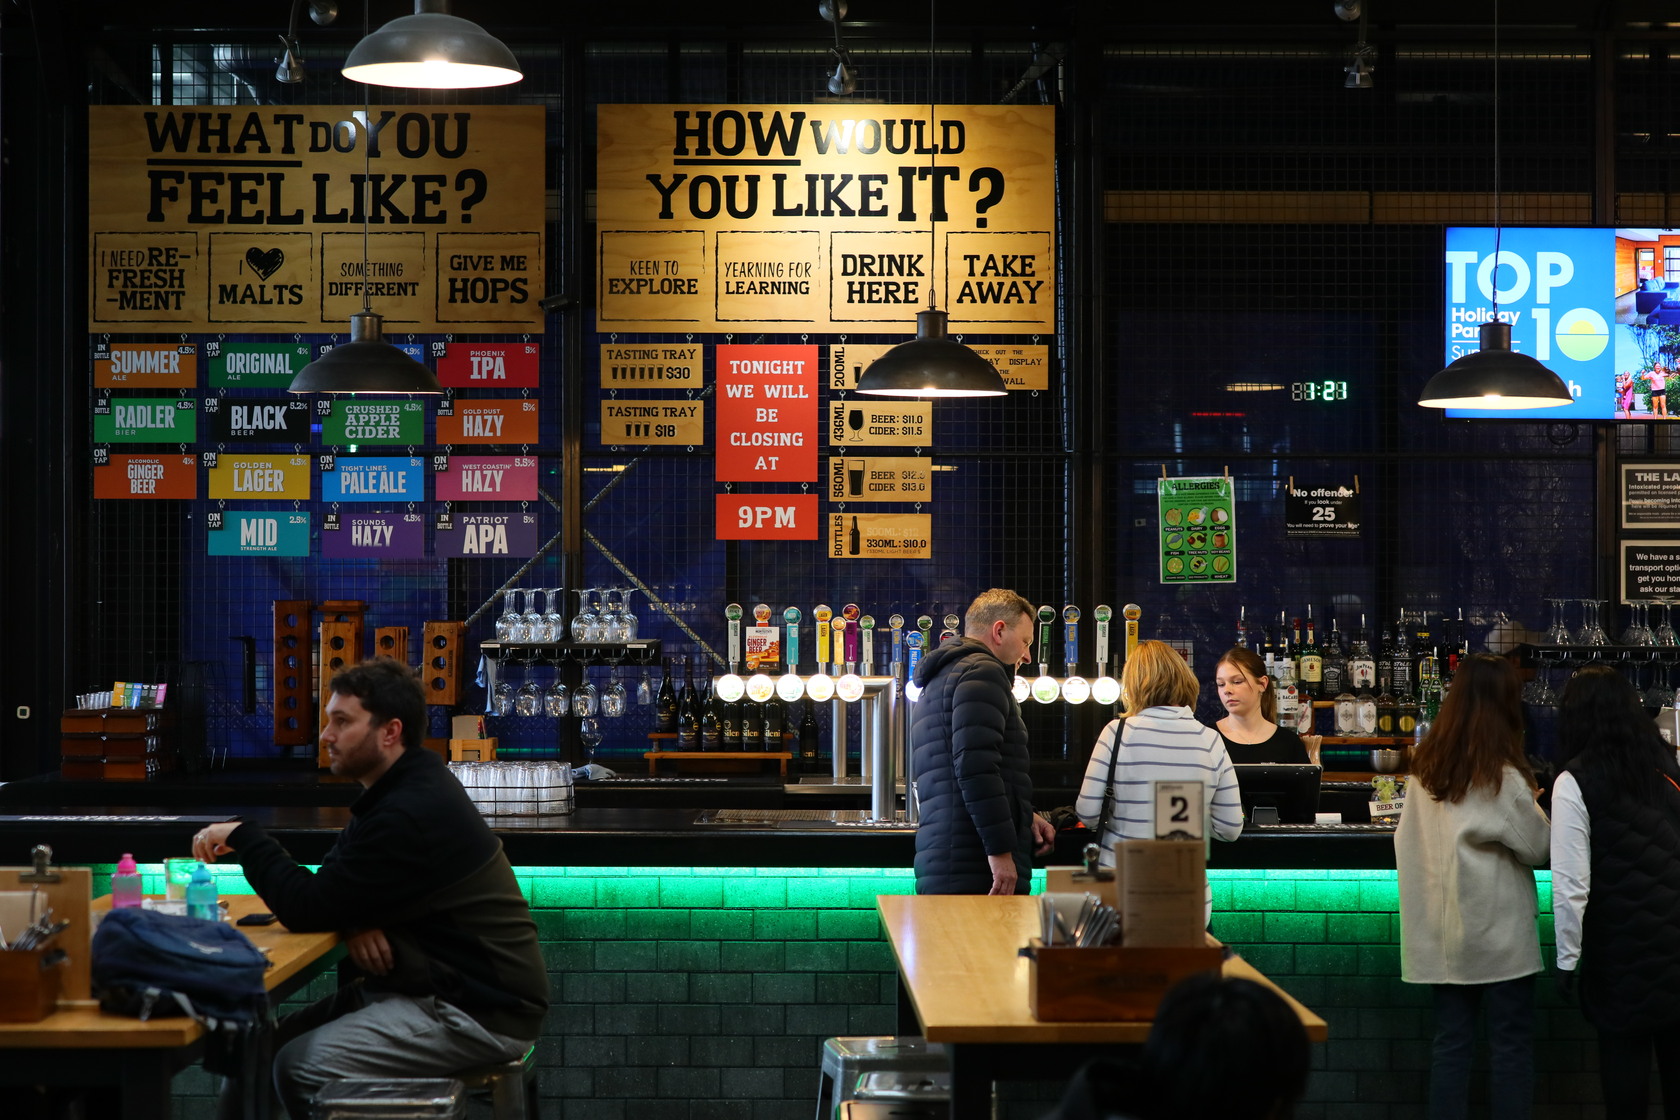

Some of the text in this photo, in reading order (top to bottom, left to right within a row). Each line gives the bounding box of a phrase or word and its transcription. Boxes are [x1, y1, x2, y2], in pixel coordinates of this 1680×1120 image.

[144, 111, 471, 158] WHAT DO YOU
[673, 110, 965, 157] HOW WOULD
[147, 169, 487, 224] FEEL LIKE?
[646, 174, 760, 219] YOU
[772, 174, 889, 216] LIKE
[110, 250, 145, 268] NEED
[147, 247, 191, 267] RE-
[449, 255, 527, 271] GIVE ME
[841, 254, 925, 277] DRINK
[963, 254, 1036, 277] TAKE
[340, 261, 404, 278] SOMETHING
[630, 261, 679, 276] KEEN TO
[724, 261, 811, 278] YEARNING FOR
[107, 269, 185, 289] FRESH
[1446, 251, 1574, 304] TOP
[218, 284, 303, 305] MALTS
[329, 282, 419, 297] DIFFERENT
[448, 278, 529, 304] HOPS
[608, 279, 698, 295] EXPLORE
[725, 281, 809, 295] LEARNING
[847, 282, 919, 304] HERE
[956, 280, 1044, 304] AWAY
[106, 291, 185, 310] -MENT
[432, 342, 445, 350] ON
[607, 350, 697, 359] TASTING TRAY
[111, 351, 180, 374] SUMMER
[226, 353, 293, 374] ORIGINAL
[470, 357, 506, 379] IPA
[730, 361, 804, 374] TONIGHT
[834, 347, 845, 387] 200ML
[666, 367, 690, 380] $30
[726, 385, 808, 398] WE WILL
[115, 406, 175, 428] RADLER
[231, 406, 287, 429] BLACK
[345, 406, 400, 414] CRUSHED
[607, 407, 697, 417] TASTING TRAY
[756, 408, 778, 422] BE
[345, 415, 400, 425] APPLE
[463, 415, 504, 437] HAZY
[834, 403, 844, 441] 436ML
[871, 415, 923, 424] BEER: $11.0
[345, 427, 400, 439] CIDER
[655, 424, 676, 438] $18
[730, 432, 803, 446] CLOSING
[869, 427, 922, 435] CIDER: $11.5
[94, 449, 106, 457] ON
[434, 456, 446, 464] ON
[128, 465, 164, 479] GINGER
[755, 457, 779, 470] AT
[233, 470, 284, 492] LAGER
[341, 472, 406, 493] PALE ALE
[462, 470, 503, 492] HAZY
[871, 472, 895, 480] BEER
[1635, 473, 1659, 481] THE
[130, 480, 156, 494] BEER
[869, 483, 895, 491] CIDER
[1172, 482, 1220, 490] ALLERGIES
[1293, 489, 1307, 497] No
[208, 513, 220, 521] ON
[738, 506, 796, 528] 9PM
[1312, 507, 1335, 521] 25
[241, 519, 277, 545] MID
[352, 526, 393, 547] HAZY
[463, 525, 508, 554] APA
[834, 515, 843, 556] BOTTLES
[867, 540, 927, 548] 330ML: $10.0
[1170, 797, 1188, 823] 2
